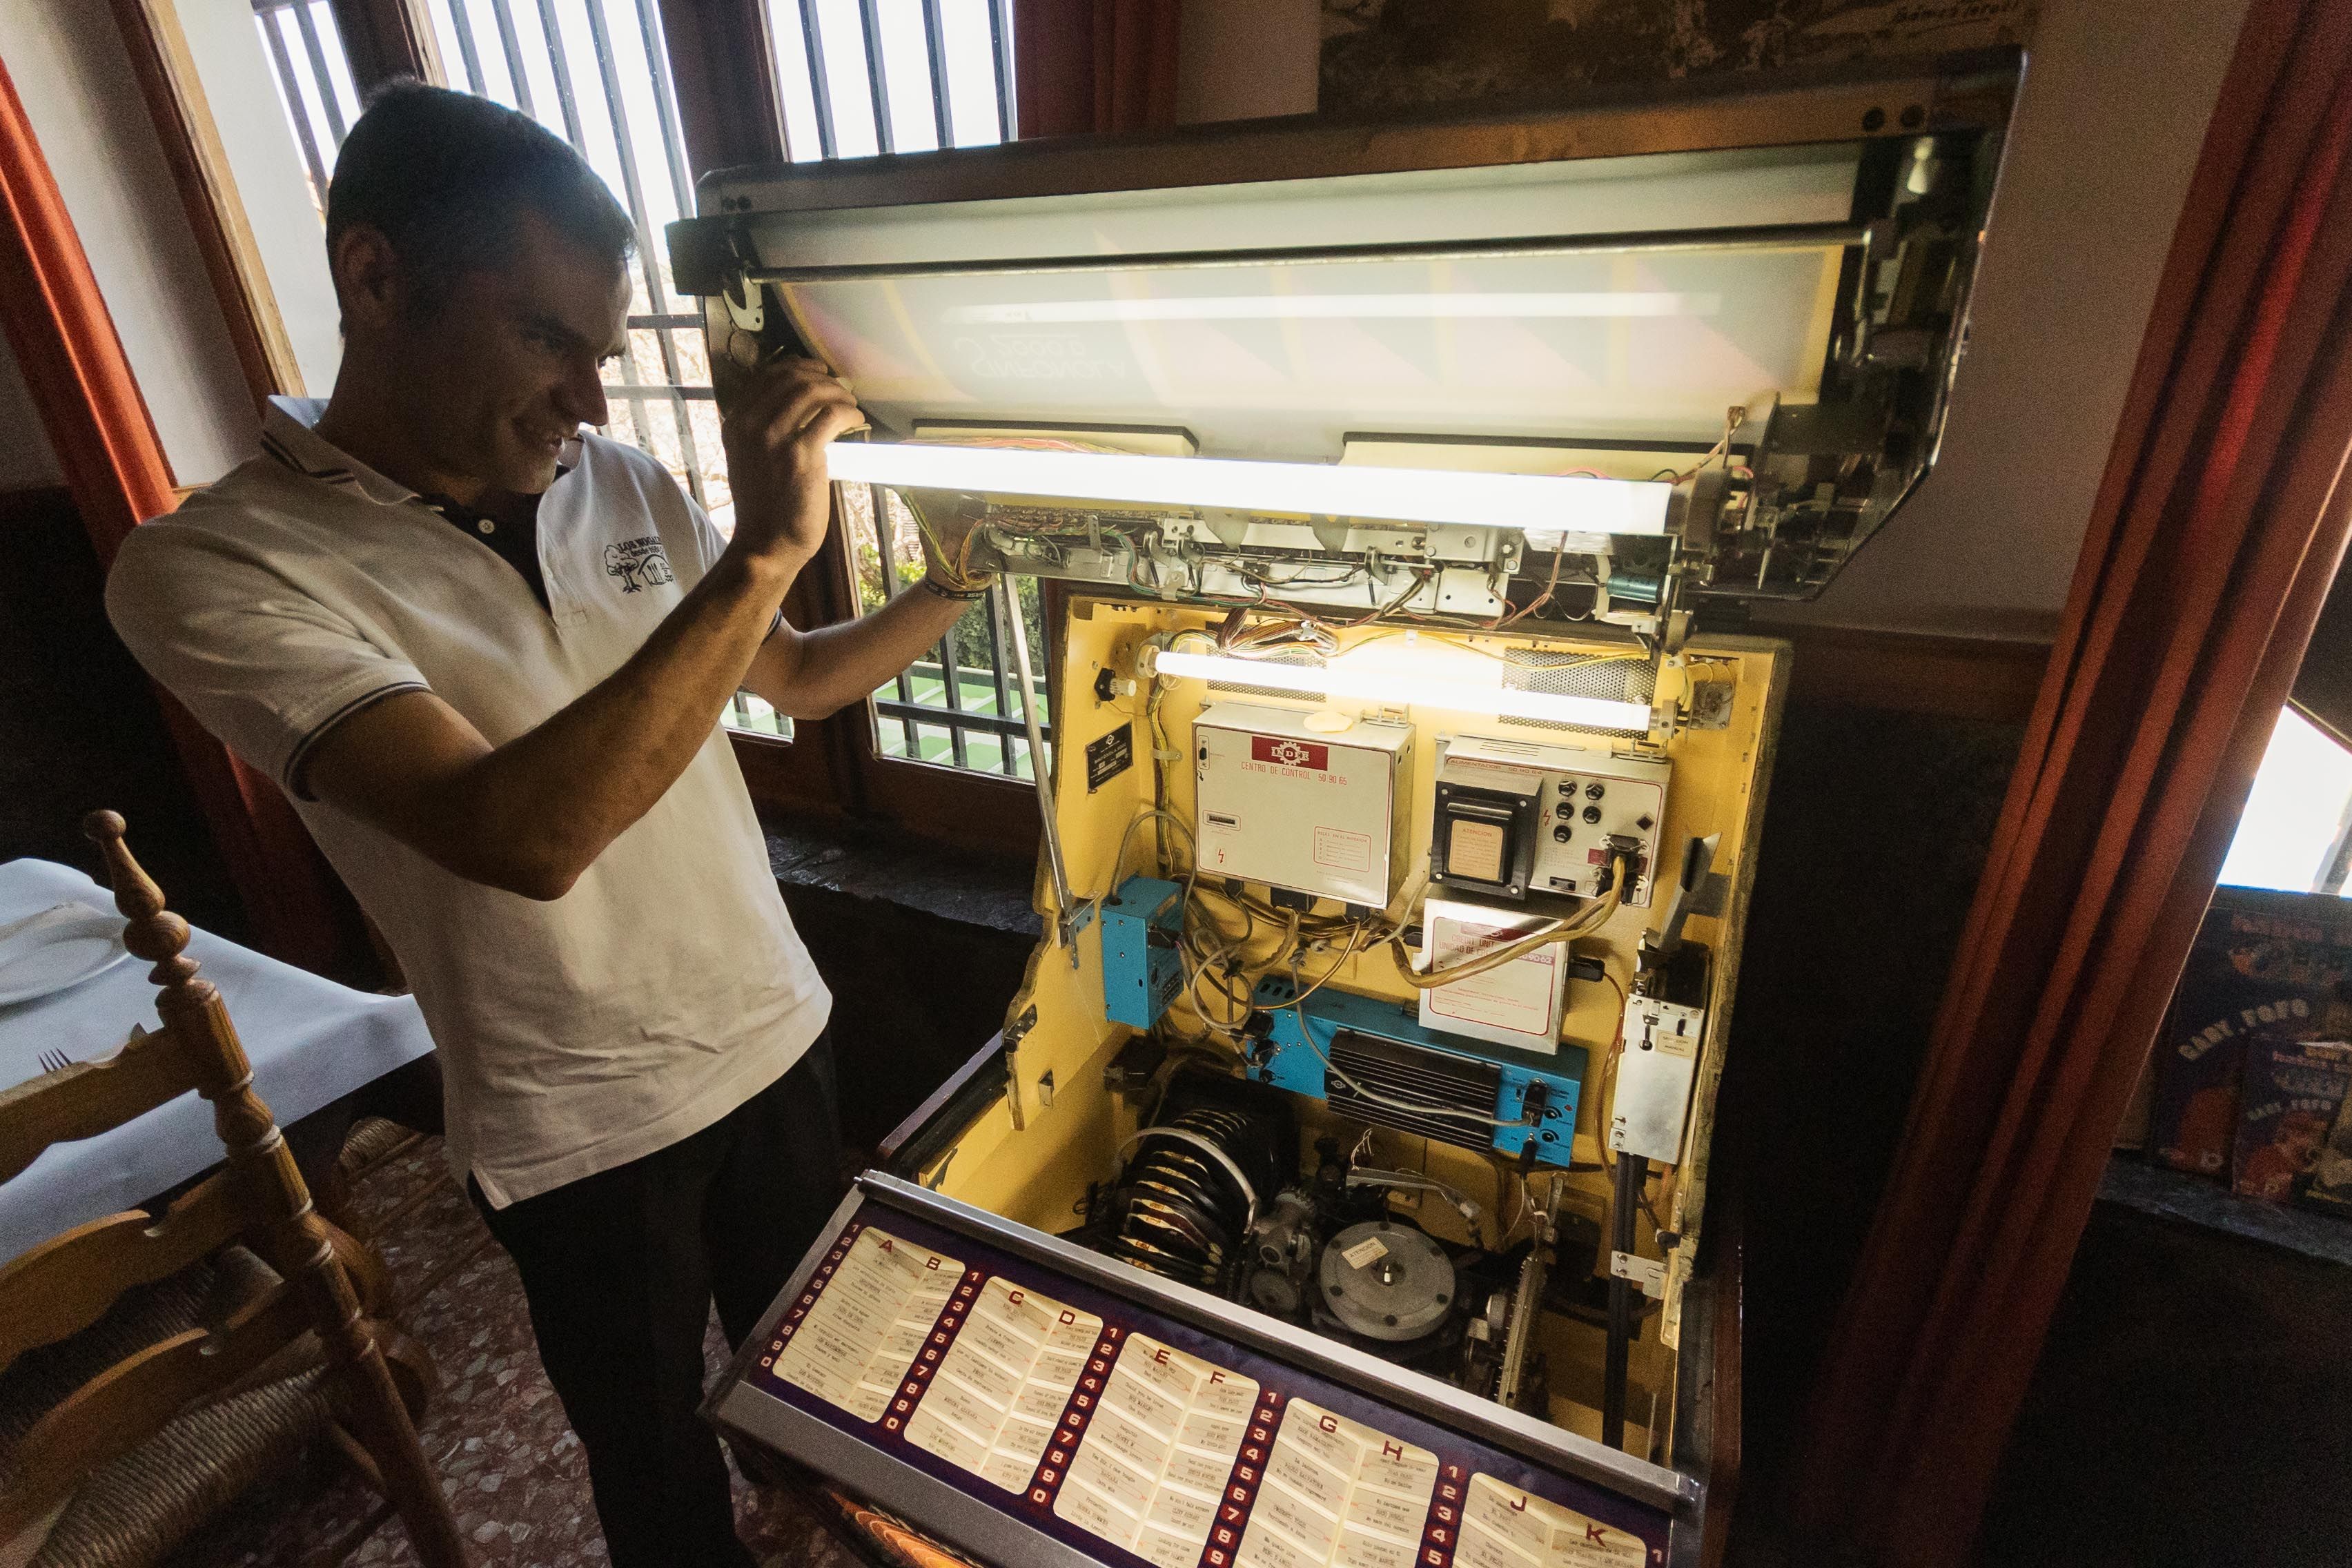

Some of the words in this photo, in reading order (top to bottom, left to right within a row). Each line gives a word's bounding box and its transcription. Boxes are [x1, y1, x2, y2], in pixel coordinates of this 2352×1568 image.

[617, 540, 637, 553] LOS
[1271, 746, 1309, 761] INDER
[1451, 760, 1502, 770] ALIMENTADOR
[1241, 762, 1266, 773] CENTRO
[1270, 767, 1278, 775] DE
[1282, 768, 1311, 780] CONTROL
[1318, 774, 1326, 783] 50
[1329, 775, 1337, 784] 90
[1339, 776, 1348, 785] 65
[1439, 940, 1464, 953] UNIDAD
[1466, 946, 1473, 954] DE
[1452, 934, 1474, 945] CREDIT
[1479, 939, 1495, 948] UNIT
[852, 1224, 859, 1233] 1
[841, 1237, 852, 1246] 2
[878, 1239, 893, 1253] A
[832, 1251, 843, 1260] 3
[925, 1256, 941, 1271] B
[822, 1266, 832, 1275] 4
[972, 1272, 979, 1281] 1
[812, 1280, 823, 1289] 5
[961, 1286, 972, 1297] 2
[1008, 1290, 1024, 1306] C
[803, 1294, 813, 1304] 6
[952, 1301, 964, 1311] 3
[794, 1309, 804, 1318] 7
[1058, 1309, 1075, 1326] D
[943, 1317, 954, 1327] 4
[782, 1325, 793, 1335] 8
[1110, 1328, 1118, 1338] 1
[934, 1332, 946, 1344] 5
[772, 1340, 783, 1351] 9
[1100, 1343, 1113, 1355] 2
[925, 1349, 937, 1360] 6
[1153, 1348, 1171, 1364] E
[761, 1357, 772, 1367] 0
[1092, 1360, 1105, 1372] 3
[917, 1365, 928, 1376] 7
[1084, 1378, 1096, 1389] 4
[1209, 1371, 1226, 1385] F
[906, 1382, 918, 1394] 8
[1077, 1394, 1089, 1407] 5
[1268, 1392, 1277, 1404] 1
[896, 1400, 908, 1411] 9
[1068, 1413, 1081, 1426] 6
[1260, 1409, 1273, 1422] 2
[886, 1417, 899, 1429] 0
[1319, 1415, 1338, 1433] G
[1061, 1431, 1073, 1442] 7
[1253, 1428, 1266, 1441] 3
[1050, 1450, 1064, 1464] 8
[1246, 1448, 1259, 1460] 4
[1382, 1440, 1403, 1461] H
[1042, 1469, 1055, 1482] 9
[1239, 1466, 1253, 1480] 5
[1449, 1465, 1458, 1478] 1
[1032, 1489, 1046, 1503] 0
[1233, 1487, 1246, 1501] 6
[1442, 1484, 1456, 1500] 2
[1509, 1496, 1528, 1513] J
[1228, 1507, 1239, 1520] 7
[1438, 1506, 1451, 1520] 3
[1217, 1529, 1231, 1544] 8
[1432, 1529, 1444, 1542] 4
[1586, 1523, 1608, 1548] K
[1210, 1549, 1224, 1565] 9
[1427, 1549, 1442, 1565] 5
[1652, 1549, 1662, 1562] 1
